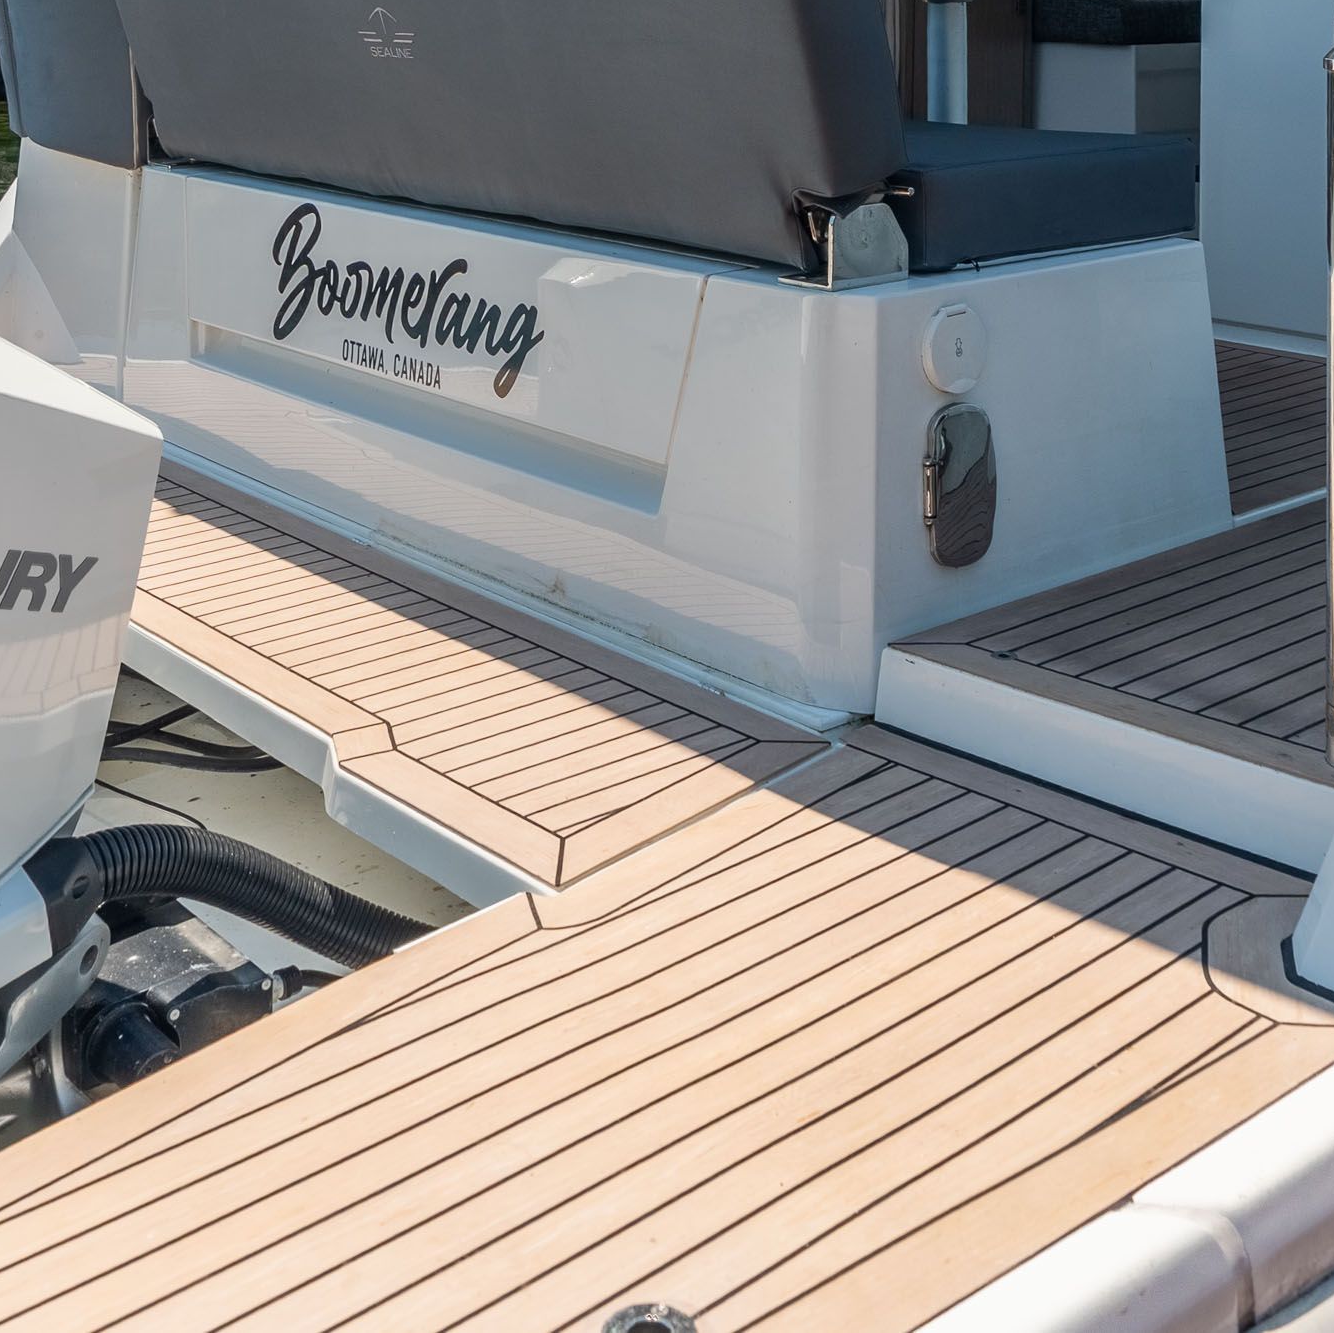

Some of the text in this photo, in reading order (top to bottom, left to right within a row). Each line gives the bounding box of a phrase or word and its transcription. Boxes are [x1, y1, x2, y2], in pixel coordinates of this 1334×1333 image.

[370, 46, 414, 59] SEALINE
[272, 202, 545, 399] Boomerang
[342, 338, 441, 390] OTTAWA, CANADA
